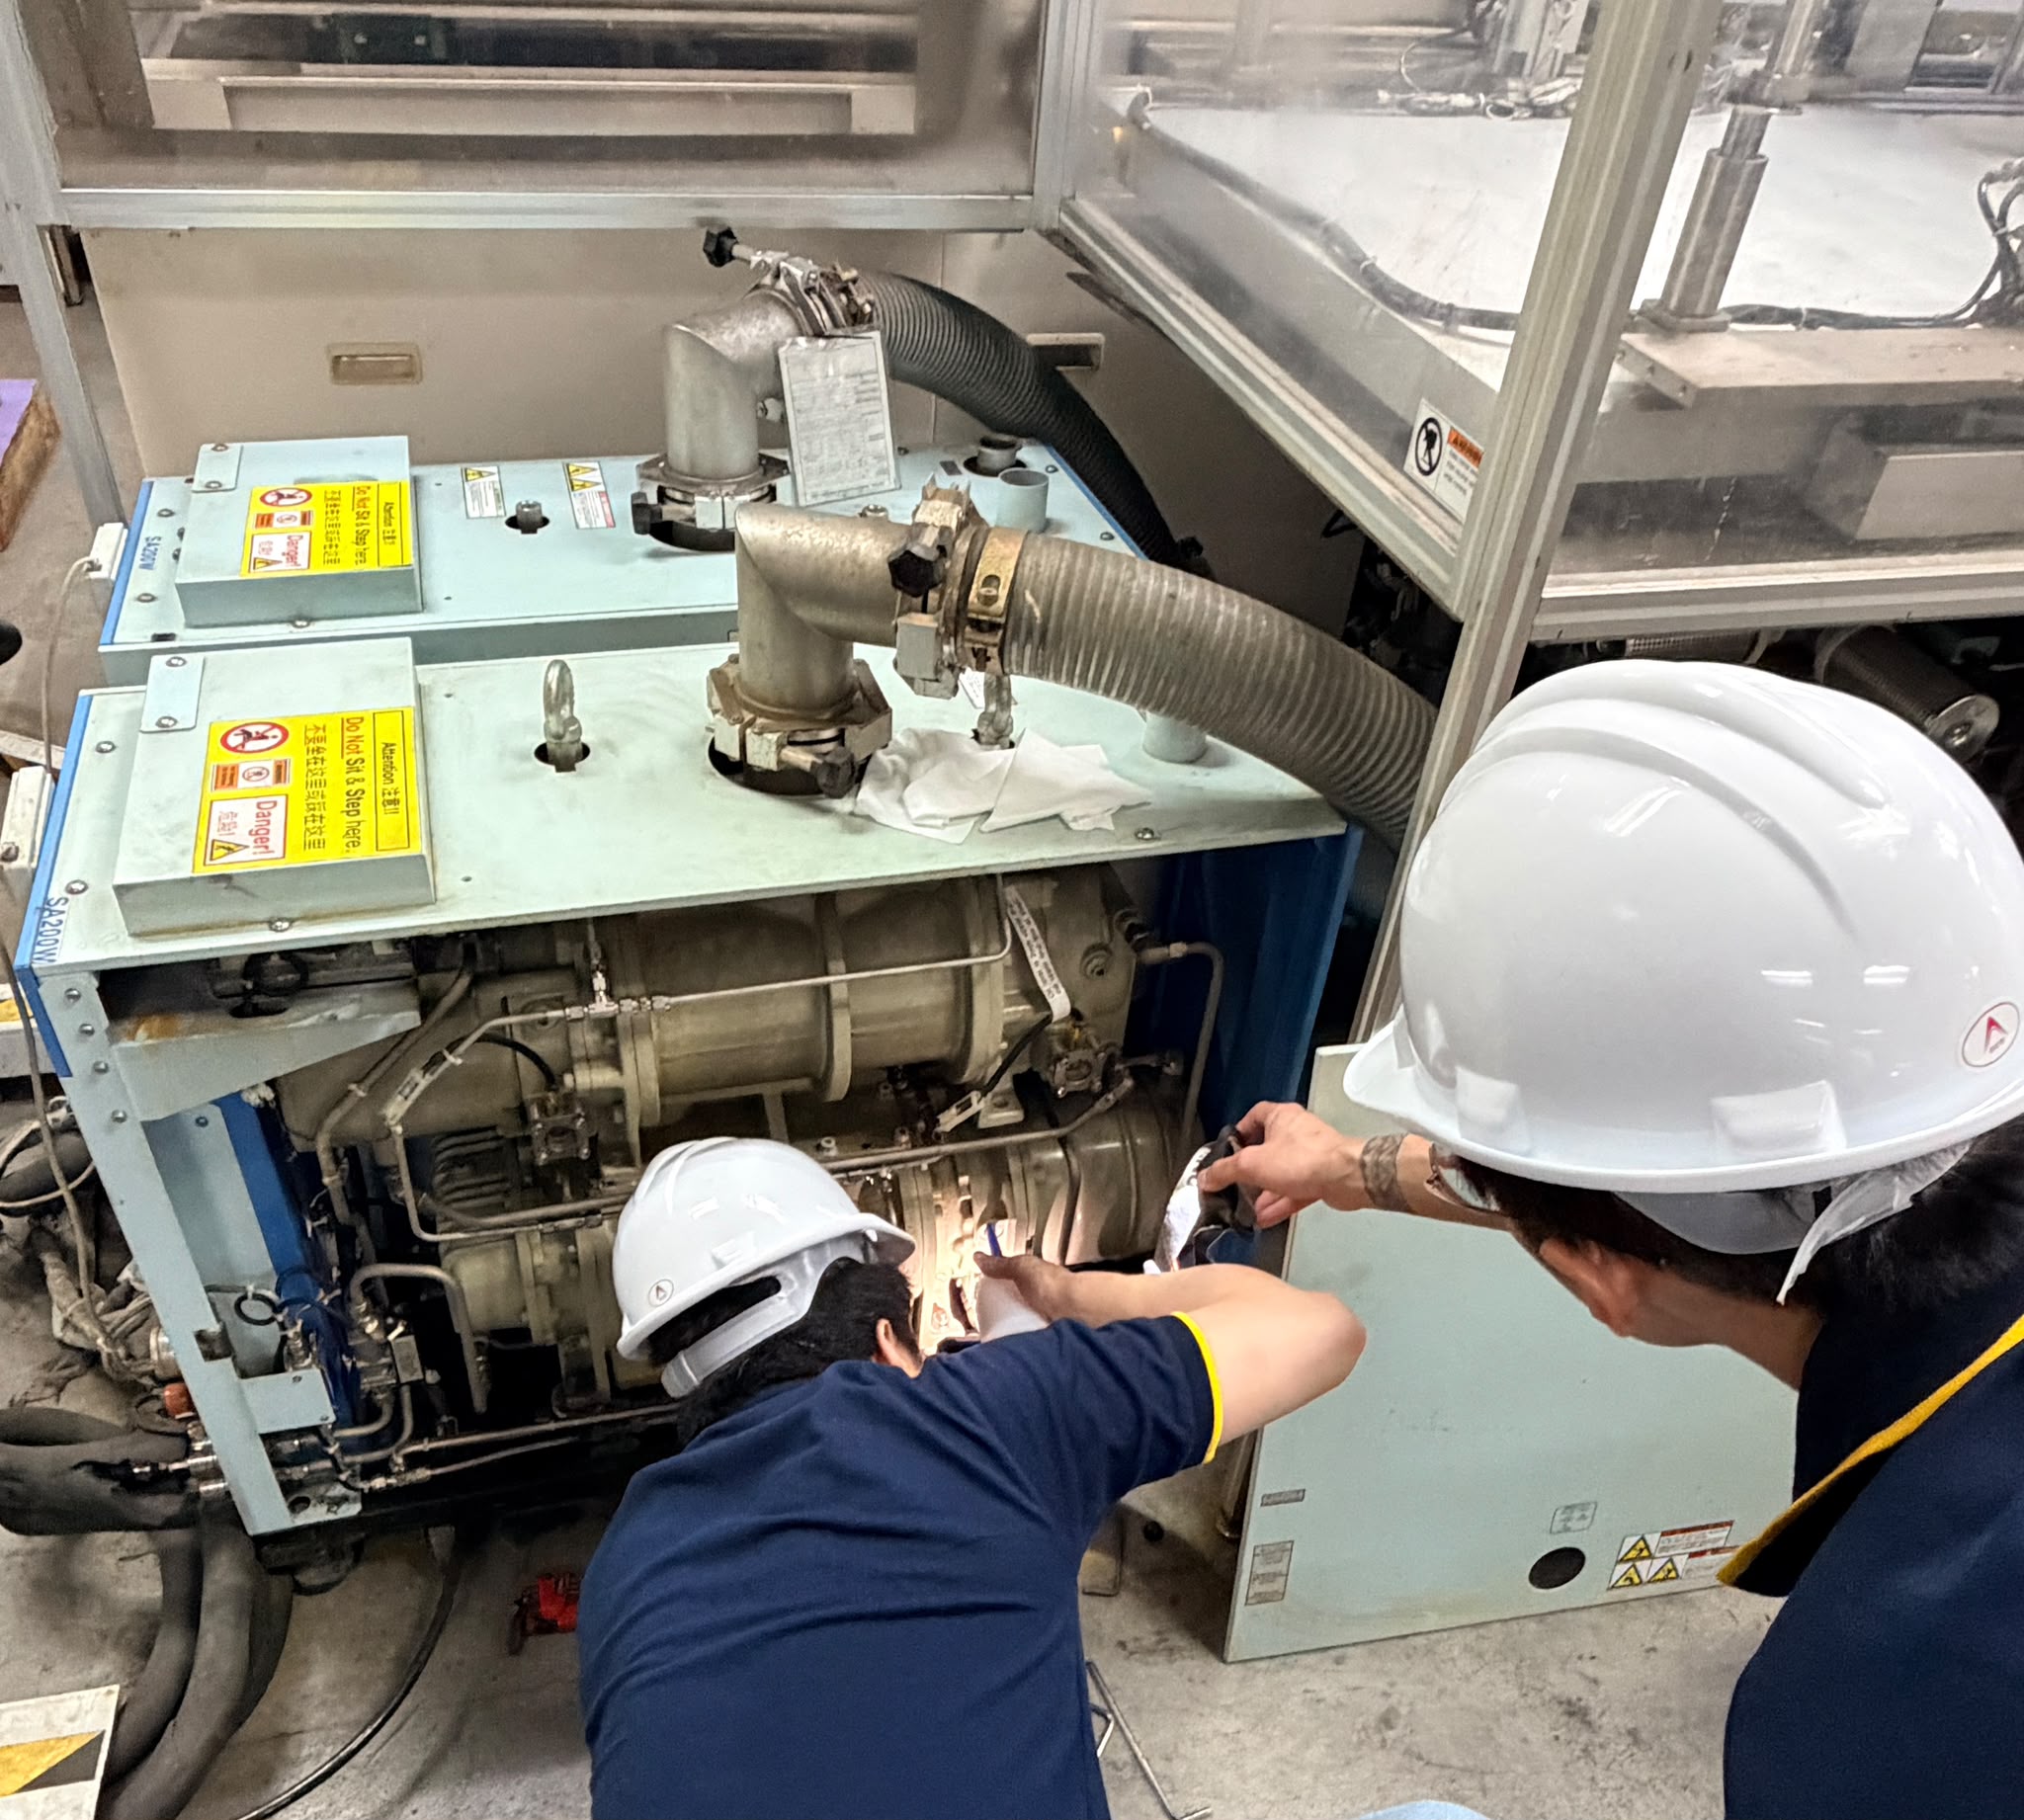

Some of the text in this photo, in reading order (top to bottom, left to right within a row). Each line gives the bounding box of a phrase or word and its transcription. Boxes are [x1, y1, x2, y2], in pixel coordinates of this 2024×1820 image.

[345, 716, 365, 733] Do
[345, 734, 365, 755] Not
[345, 758, 366, 775] Sit
[381, 742, 397, 786] Attention
[345, 777, 366, 786] &
[341, 786, 366, 817] Step
[248, 800, 278, 856] Danger!
[32, 896, 69, 963] SA200W
